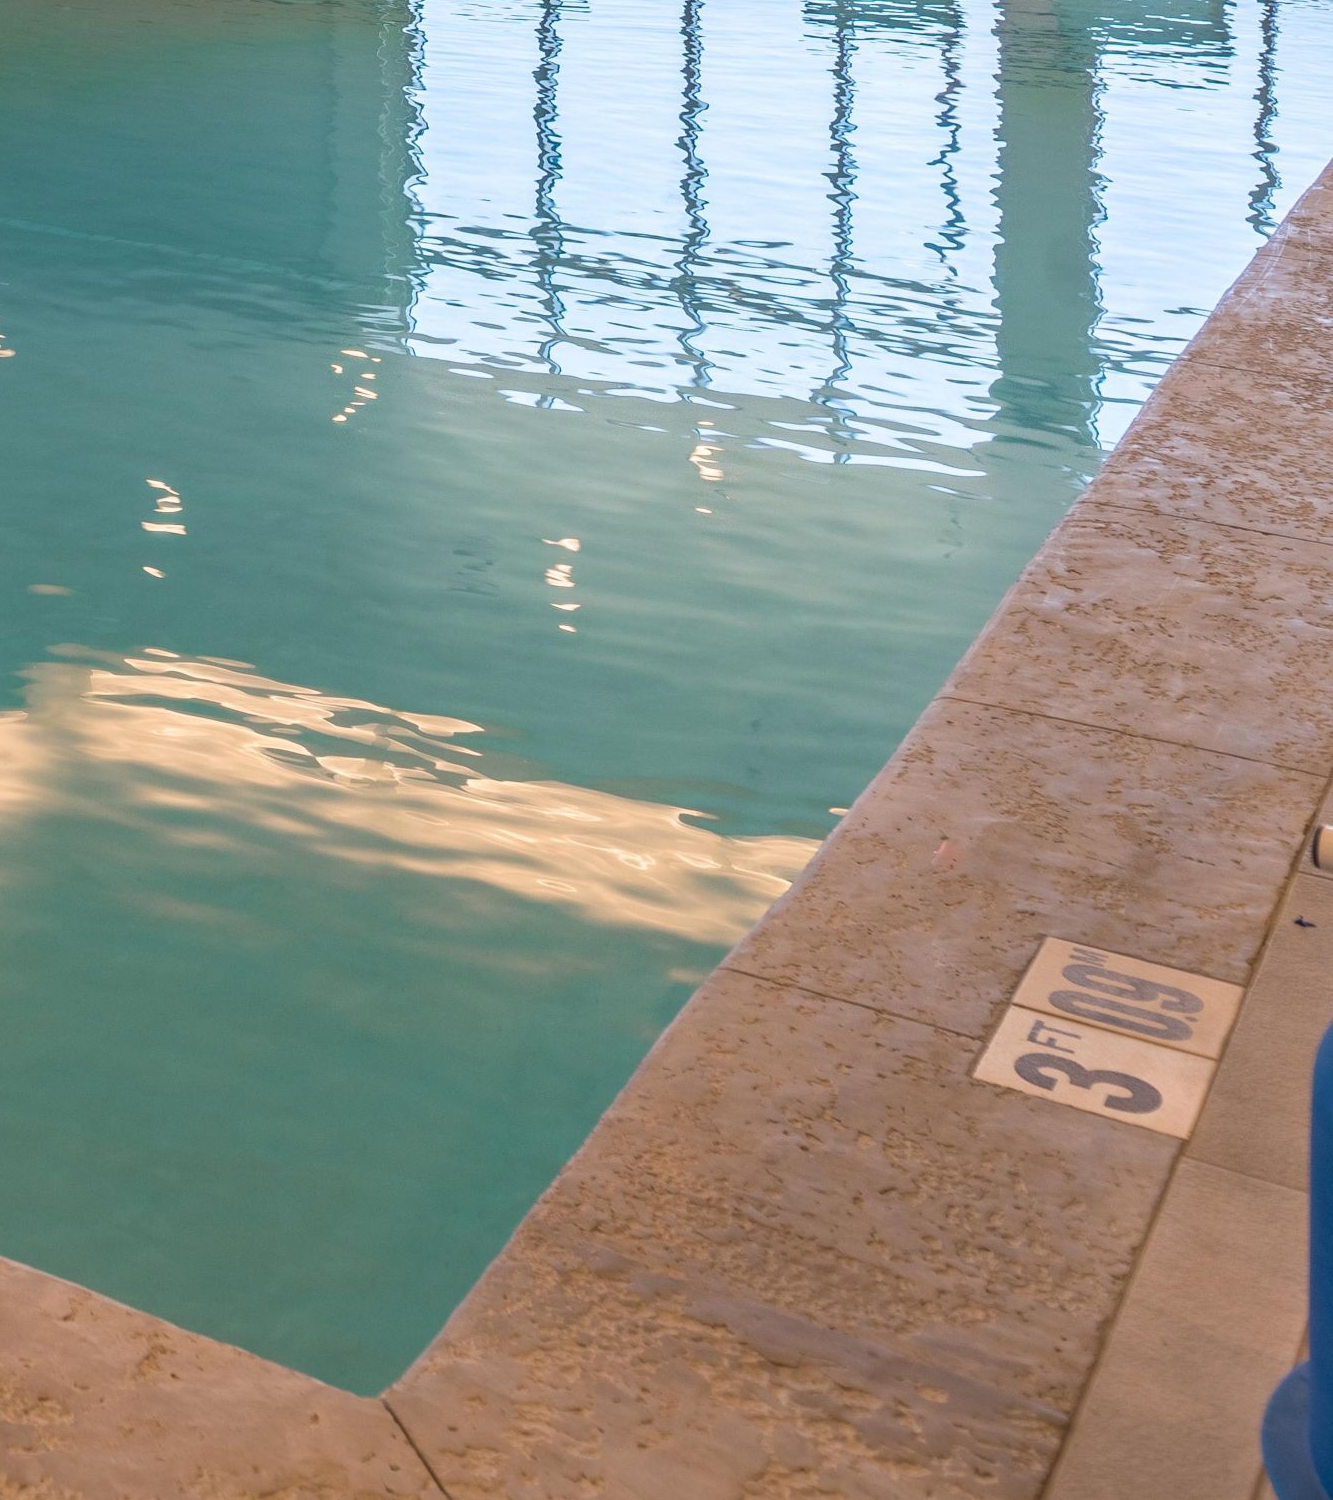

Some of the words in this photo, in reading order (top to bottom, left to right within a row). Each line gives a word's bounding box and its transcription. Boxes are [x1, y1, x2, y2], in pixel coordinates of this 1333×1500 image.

[1069, 947, 1109, 967] M
[1027, 1020, 1082, 1054] FT
[1014, 1052, 1164, 1115] 3
